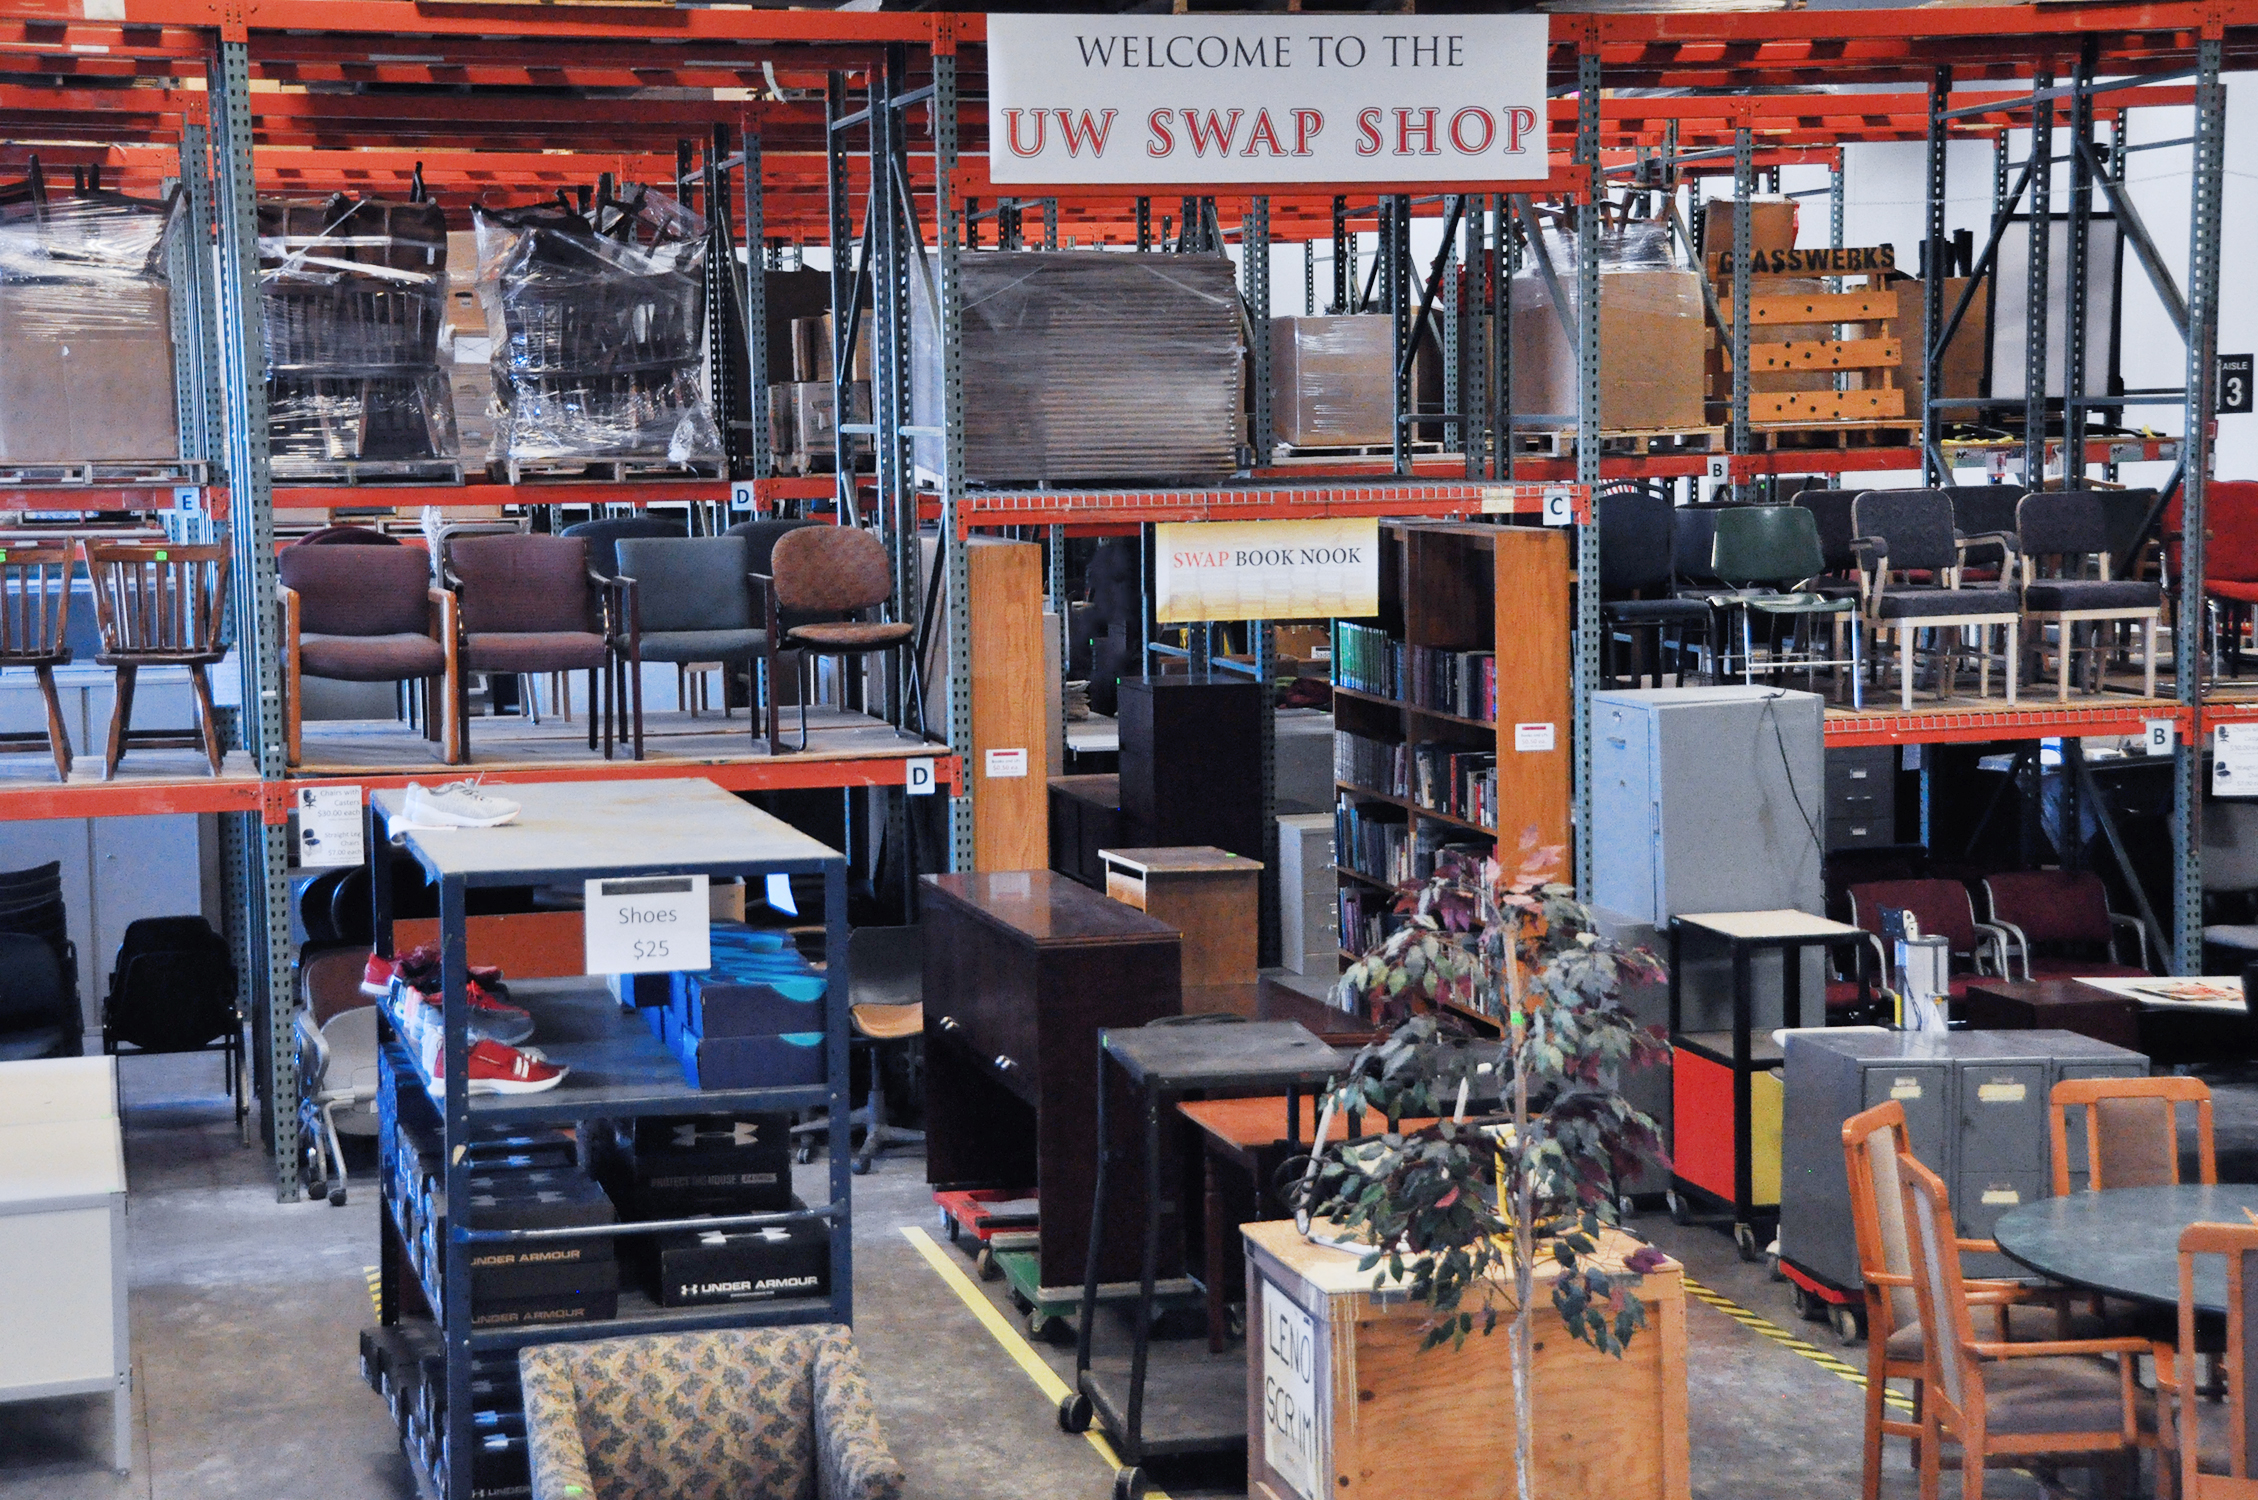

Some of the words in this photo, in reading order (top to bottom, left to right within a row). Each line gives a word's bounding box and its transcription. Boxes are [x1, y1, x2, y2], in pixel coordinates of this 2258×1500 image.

[1076, 35, 1292, 69] WELCOME
[1308, 35, 1366, 68] TO
[1382, 35, 1465, 68] THE
[1001, 107, 1119, 159] UW
[1146, 107, 1325, 158] SWAP
[1355, 106, 1538, 157] SHOP
[1719, 246, 1895, 273] GASSWERKS
[2222, 361, 2248, 370] AISLE
[2226, 377, 2243, 407] 3
[1713, 463, 1723, 477] B
[182, 494, 193, 510] E
[737, 489, 749, 504] D
[1550, 497, 1563, 516] C
[1173, 551, 1230, 569] SWAP
[1235, 549, 1295, 567] BOOK
[1300, 547, 1363, 565] NOOK
[2154, 727, 2166, 745] B
[913, 766, 928, 785] D
[320, 789, 342, 797] Chairs
[325, 831, 349, 839] Straight
[619, 906, 677, 925] Shoes
[633, 938, 670, 961] $25
[518, 1249, 582, 1263] ARMOUR
[701, 1280, 752, 1293] UNDER
[754, 1275, 819, 1290] ARMOUR
[523, 1308, 586, 1321] ARMOUR
[1268, 1302, 1311, 1384] LENO
[1266, 1375, 1313, 1465] SCRIM
